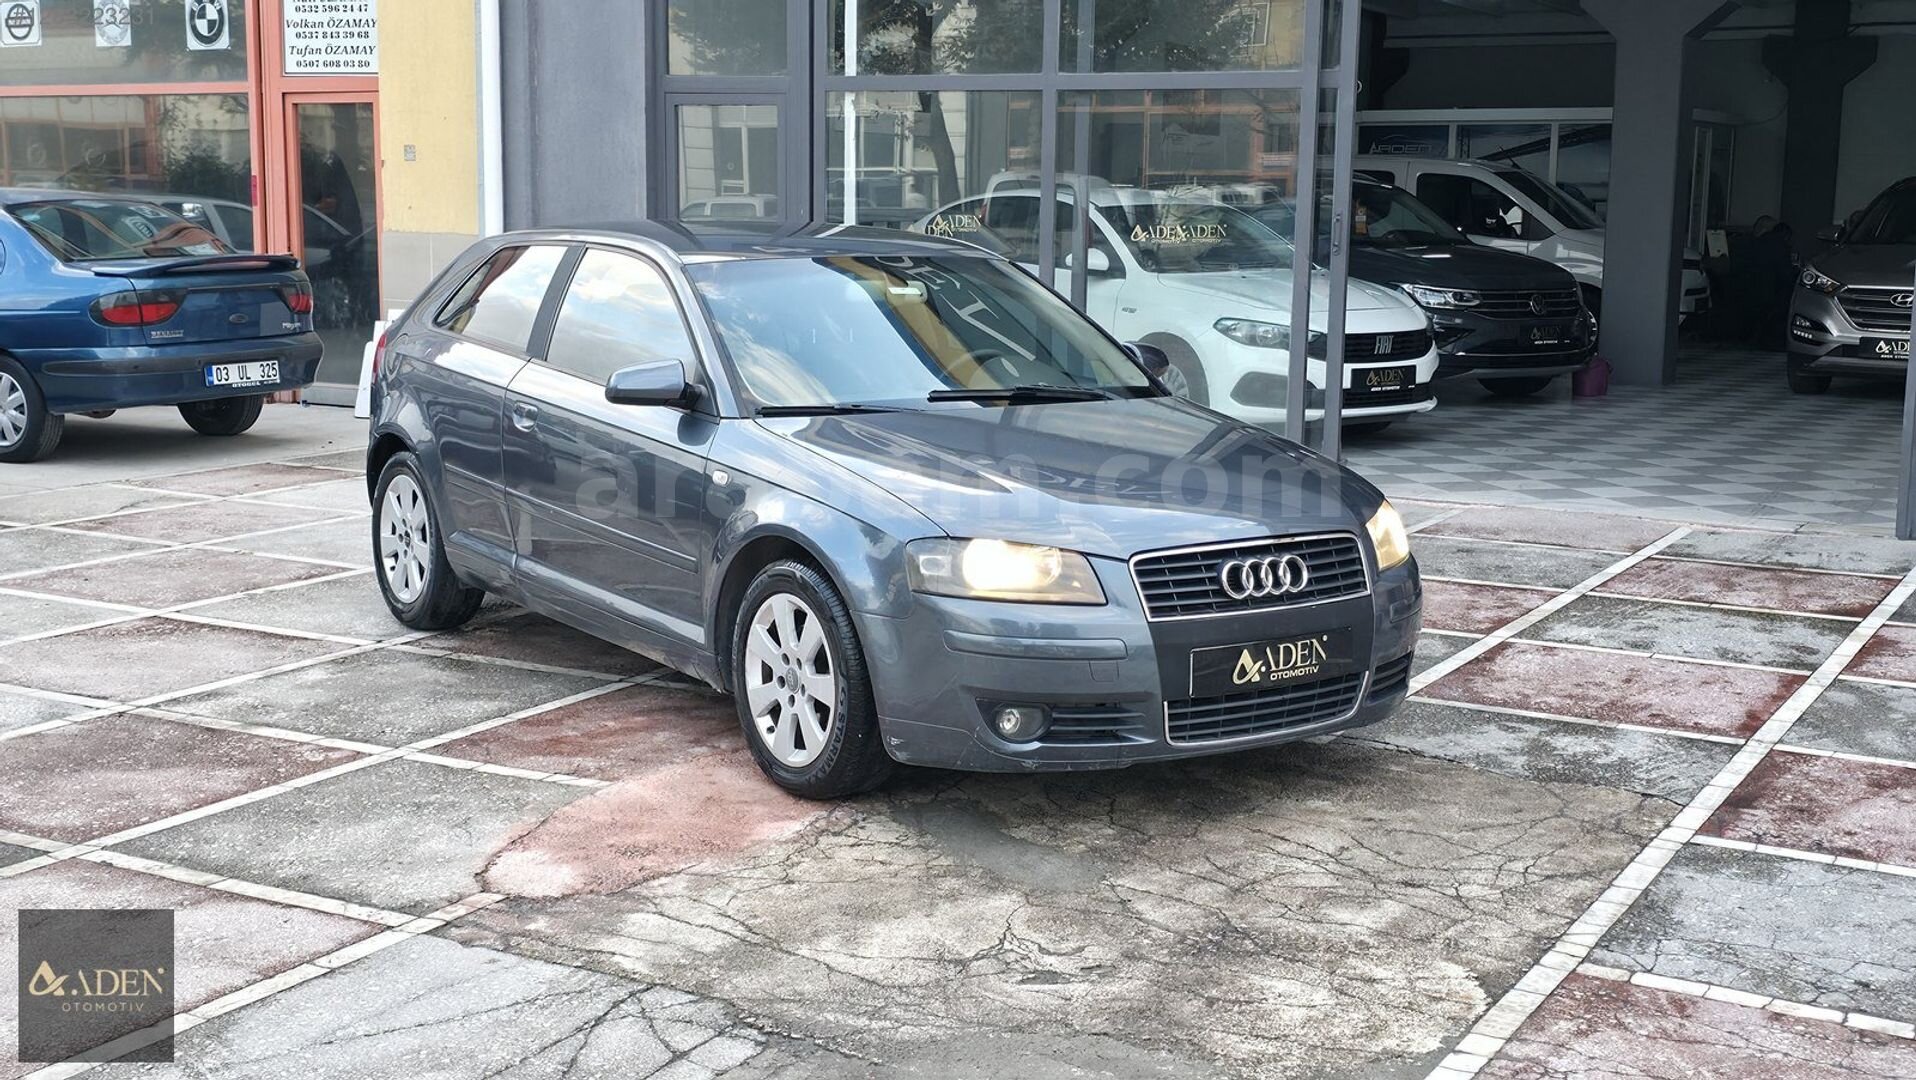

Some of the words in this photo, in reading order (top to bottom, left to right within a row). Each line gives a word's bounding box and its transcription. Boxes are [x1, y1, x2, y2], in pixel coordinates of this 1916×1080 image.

[295, 5, 319, 13] 0532
[322, 4, 340, 13] 596
[286, 18, 324, 29] Volkan
[326, 16, 377, 29] ÖZAMAY
[295, 31, 319, 39] 0537
[342, 31, 354, 39] 39
[357, 31, 369, 39] 68
[289, 44, 322, 58] Tufan
[324, 43, 376, 55] ÖZAMAY
[296, 60, 319, 68] 0507
[322, 60, 341, 68] 608
[343, 60, 355, 68] 03
[357, 60, 370, 68] 80
[216, 366, 230, 382] 03
[237, 364, 251, 381] UL
[259, 362, 278, 379] 325
[1265, 638, 1328, 672] ADEN
[1270, 665, 1320, 681] OTOMOTIV
